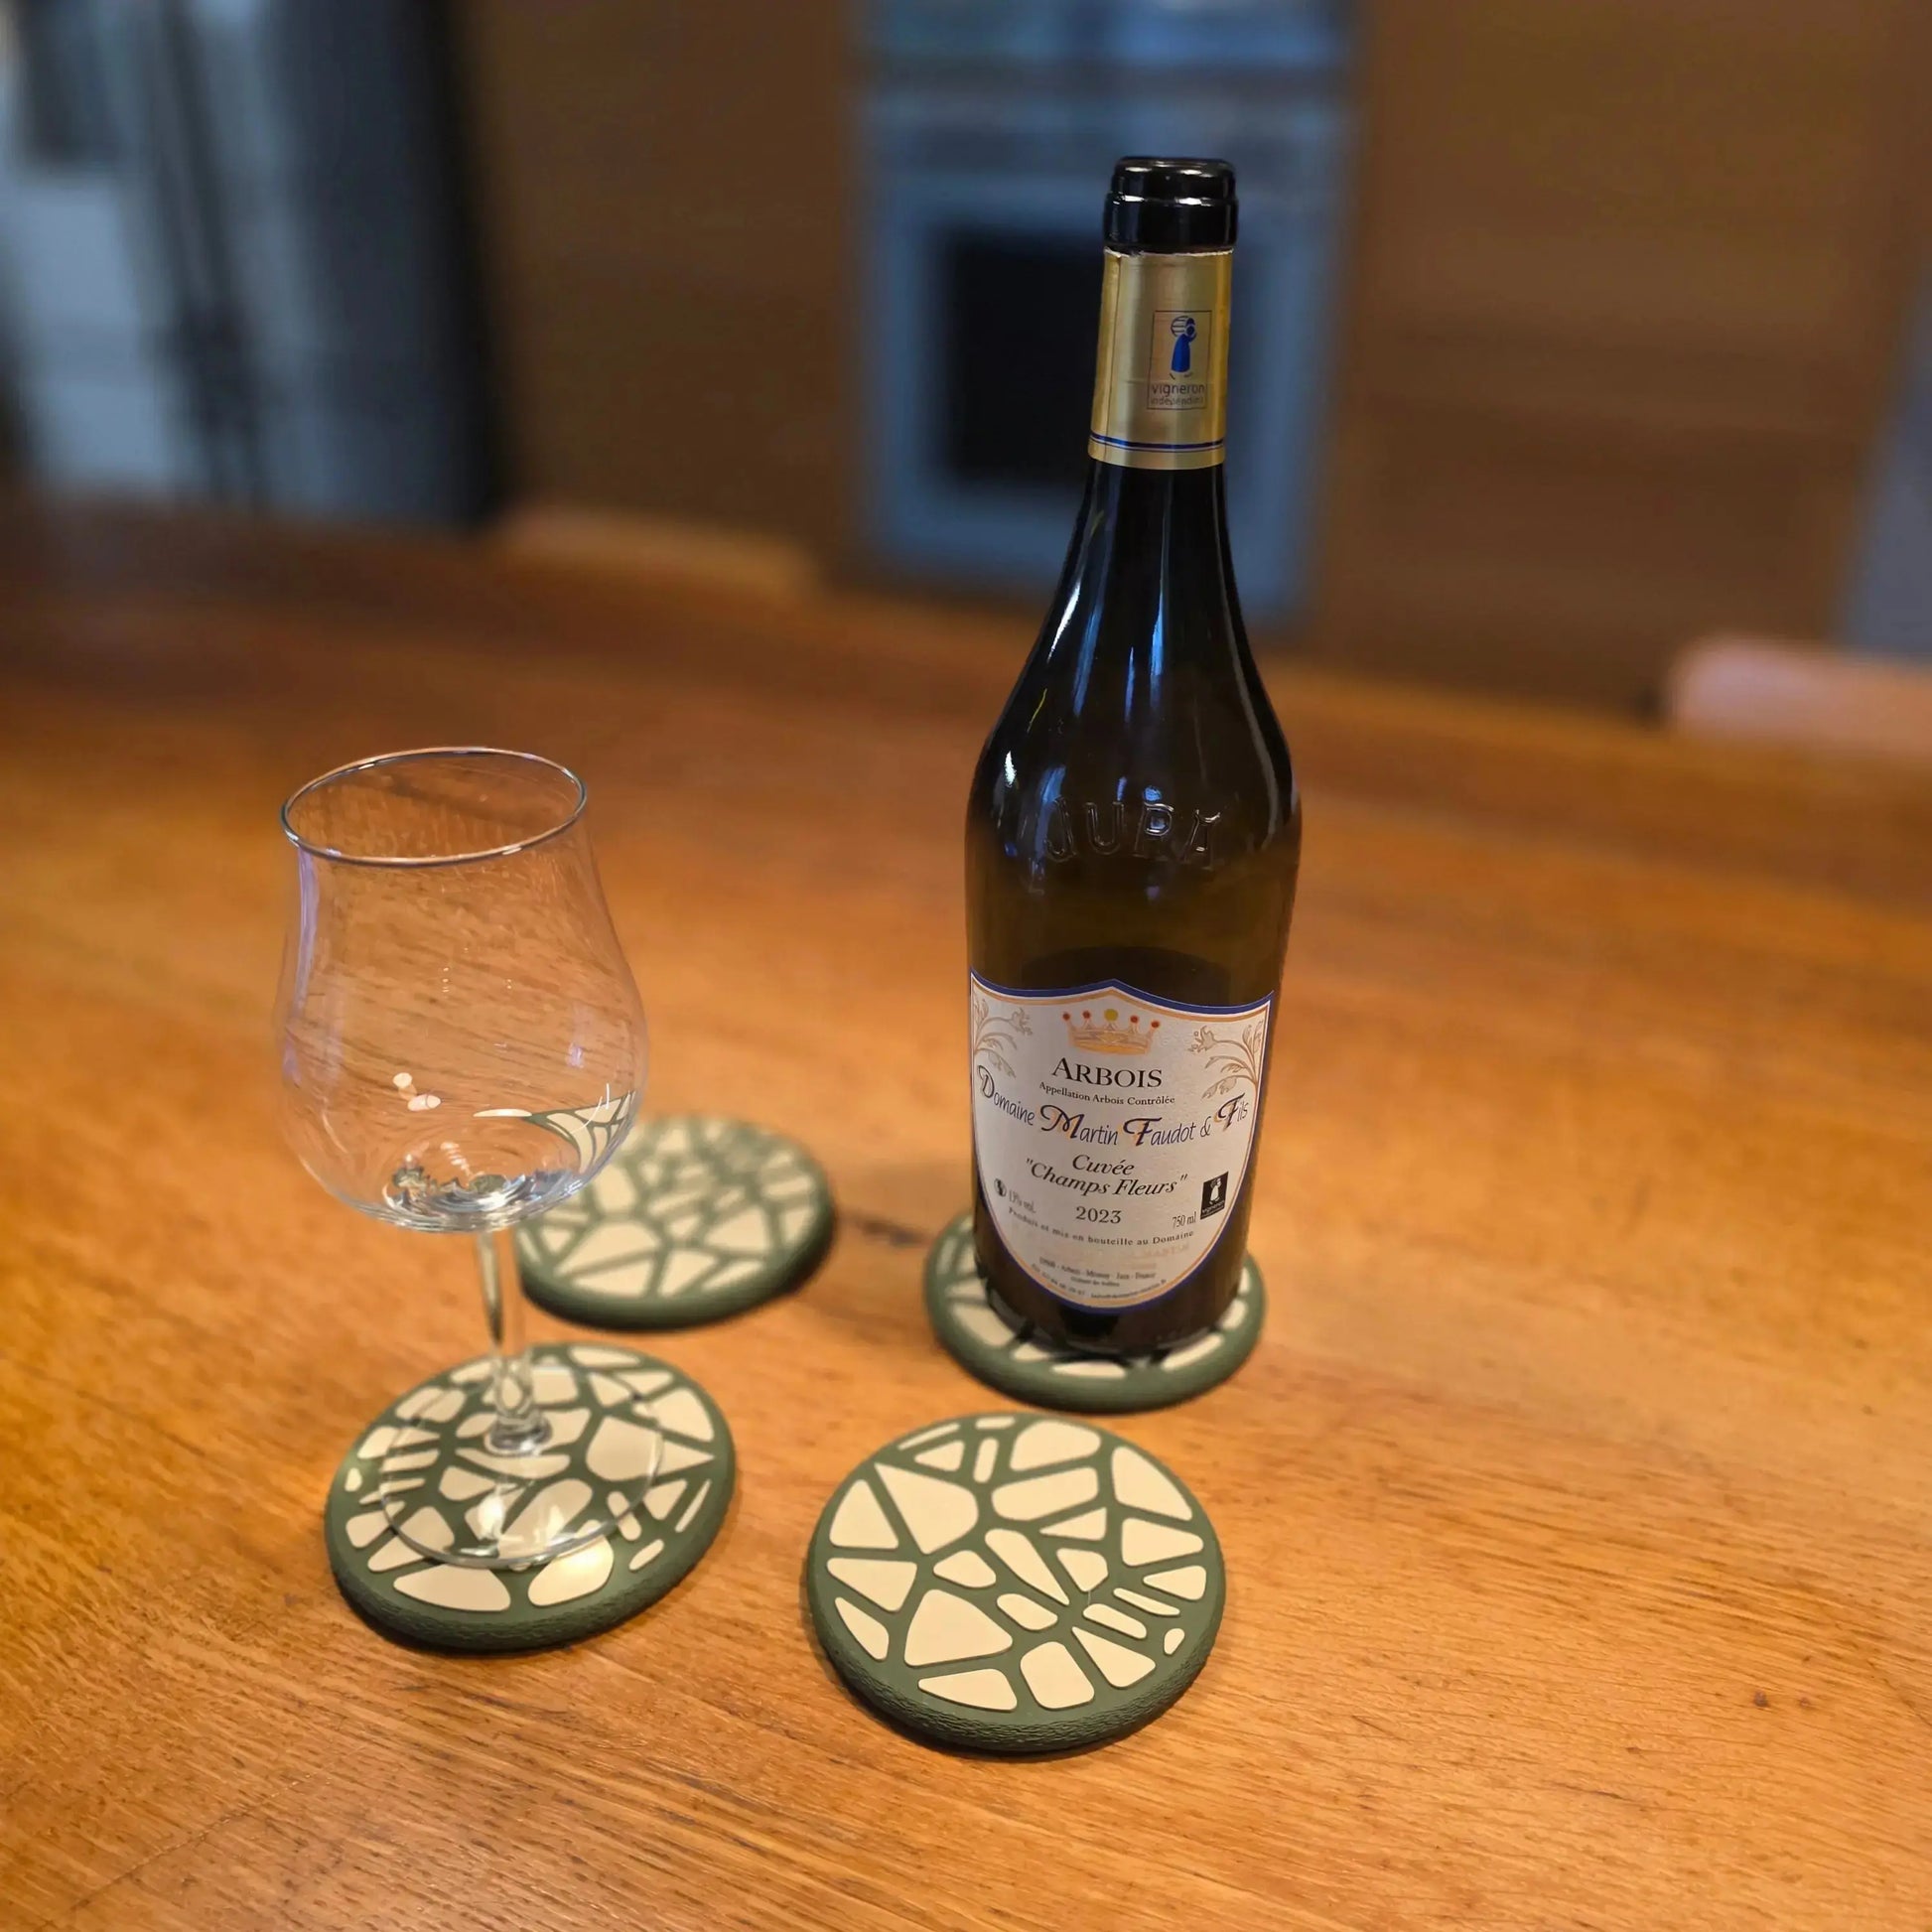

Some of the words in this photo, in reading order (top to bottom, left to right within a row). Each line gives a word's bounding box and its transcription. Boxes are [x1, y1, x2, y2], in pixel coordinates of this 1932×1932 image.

[1152, 383, 1205, 397] vigneron
[1051, 1057, 1163, 1088] ARBOIS
[1039, 1081, 1090, 1102] Appellation
[1092, 1094, 1124, 1105] Arbois
[1126, 1095, 1175, 1106] Contrôlée
[978, 1064, 1035, 1127] Domaine
[1039, 1104, 1118, 1146] Martin
[1123, 1116, 1195, 1147] Faudot
[1199, 1116, 1211, 1138] &
[1216, 1093, 1249, 1133] Fils
[1072, 1154, 1135, 1176] Cuvée
[1026, 1158, 1110, 1197] "Champs
[1114, 1173, 1188, 1196] Fleurs"
[1076, 1205, 1122, 1225] 2023
[1173, 1215, 1185, 1228] 750
[1186, 1211, 1197, 1224] ml
[1087, 1236, 1134, 1246] bouteille
[1153, 1230, 1194, 1245] Domaine
